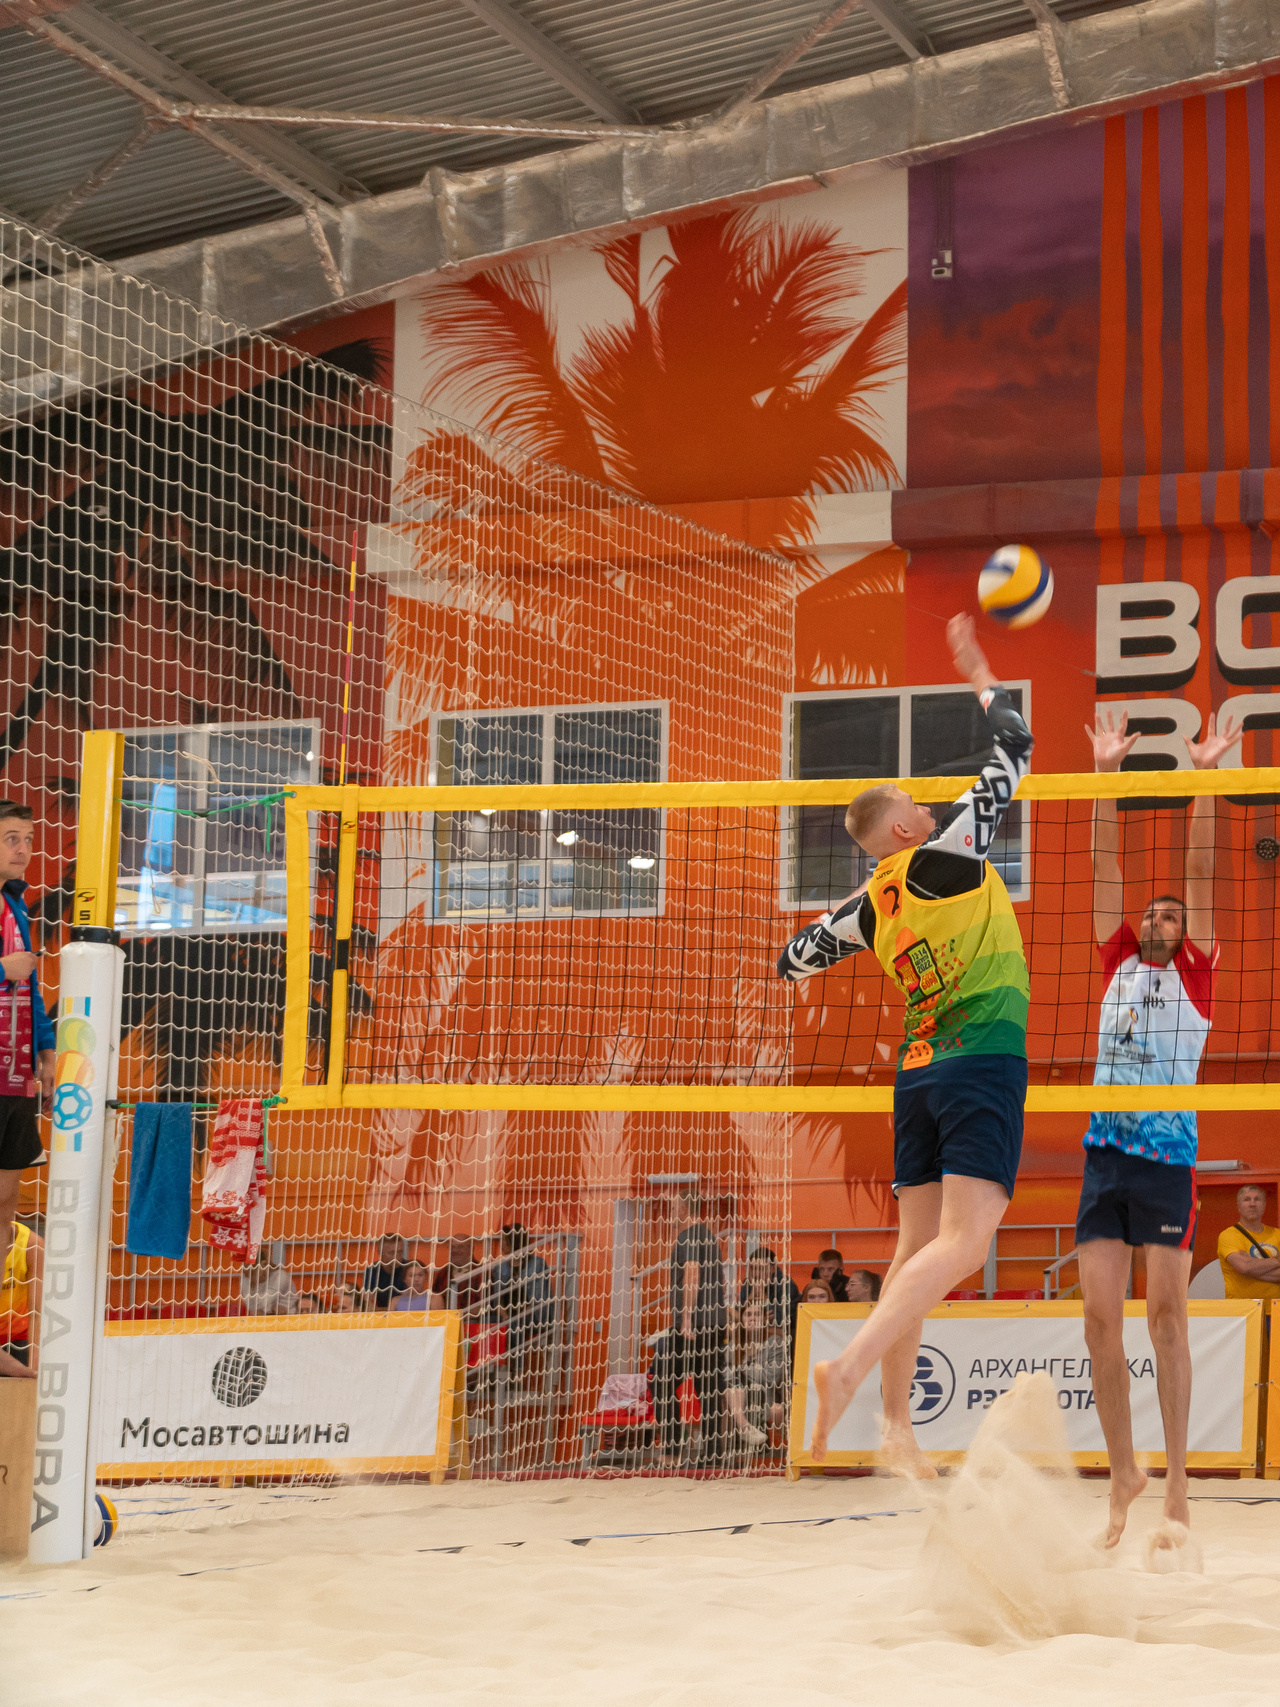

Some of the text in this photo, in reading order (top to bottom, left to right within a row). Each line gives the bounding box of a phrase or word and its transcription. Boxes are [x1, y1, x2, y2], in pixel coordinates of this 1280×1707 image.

[917, 960, 933, 974] 2022
[1142, 996, 1166, 1010] RUS
[30, 1178, 80, 1534] BORA BORA
[120, 1416, 350, 1448] Мосавтошина
